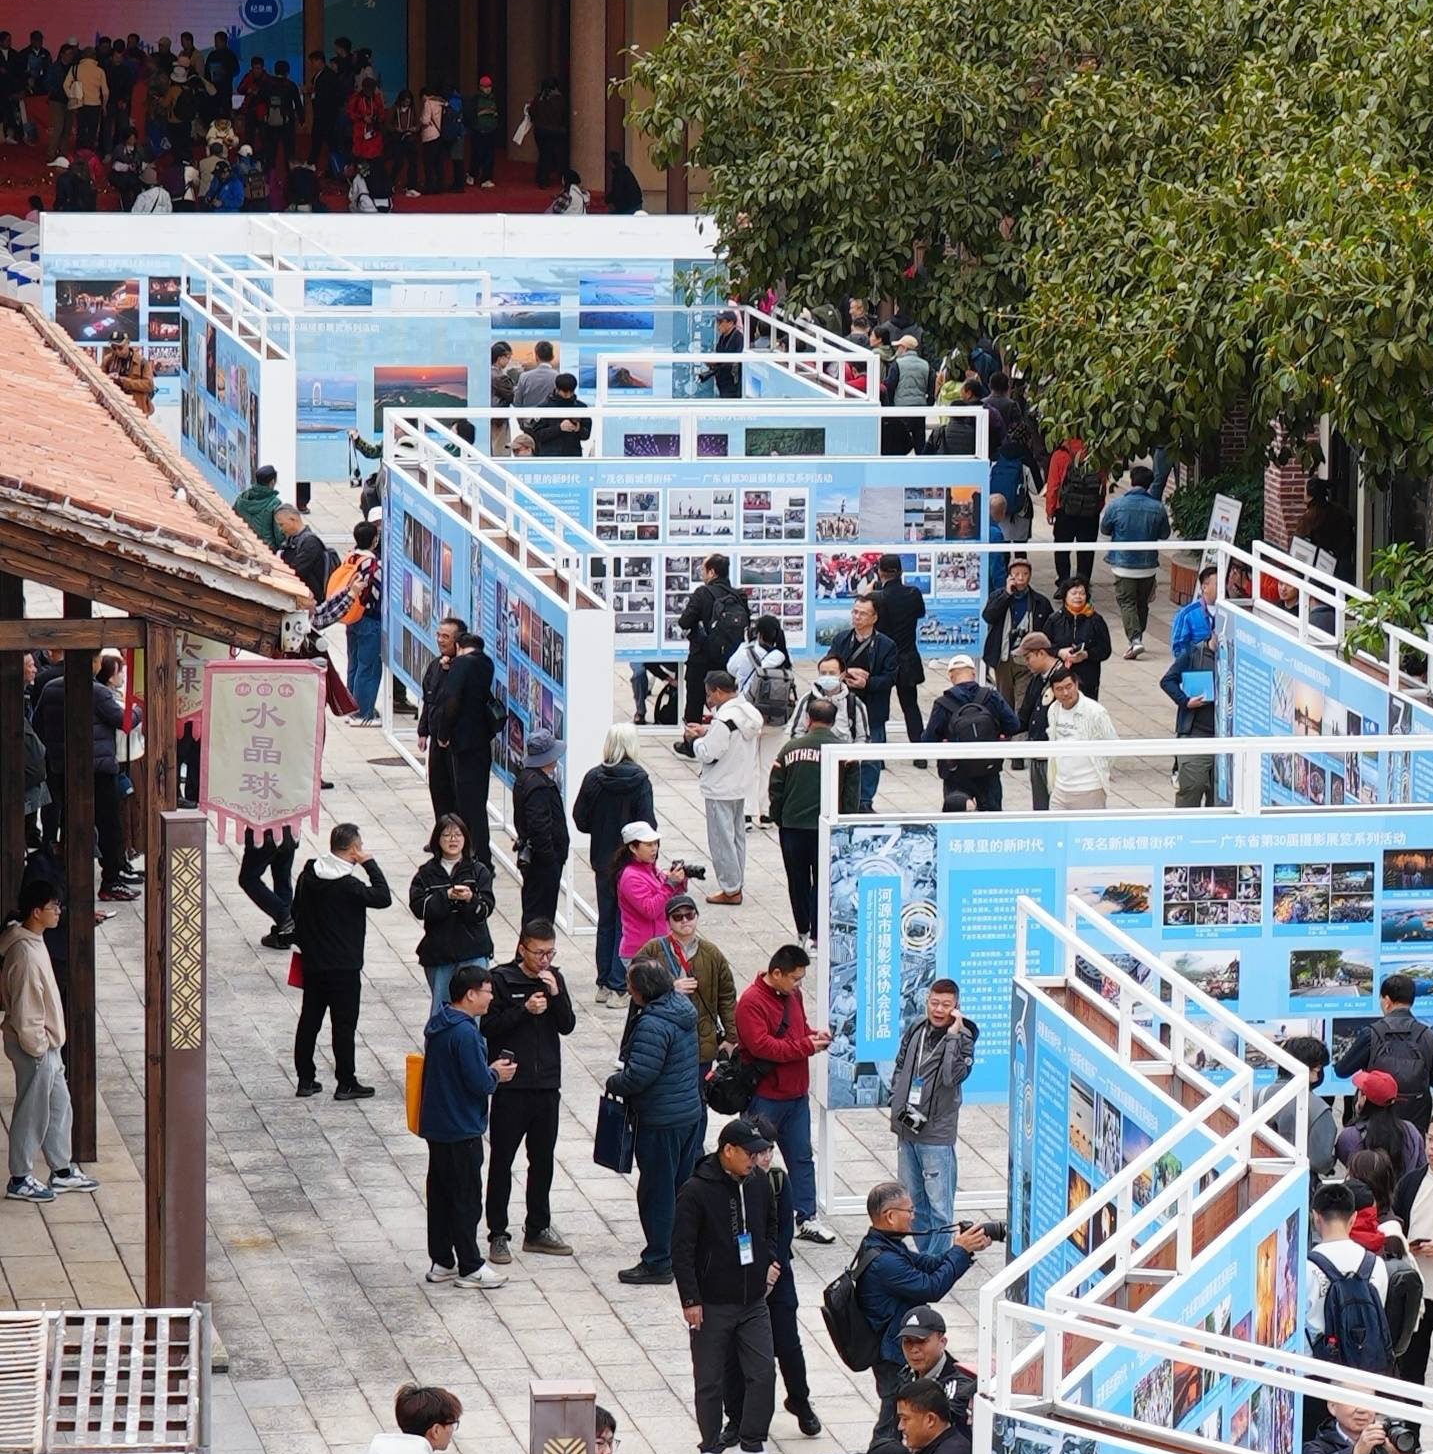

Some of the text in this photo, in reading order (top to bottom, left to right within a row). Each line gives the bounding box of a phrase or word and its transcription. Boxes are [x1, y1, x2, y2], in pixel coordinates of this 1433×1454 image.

[240, 702, 286, 800] 水晶球
[784, 748, 822, 767] AUTHEN
[948, 838, 1045, 854] 场景里的新时代
[1219, 831, 1407, 848] 广东省第30届摄影展览系列活动
[876, 887, 893, 1040] 河源市摄影家协会作品
